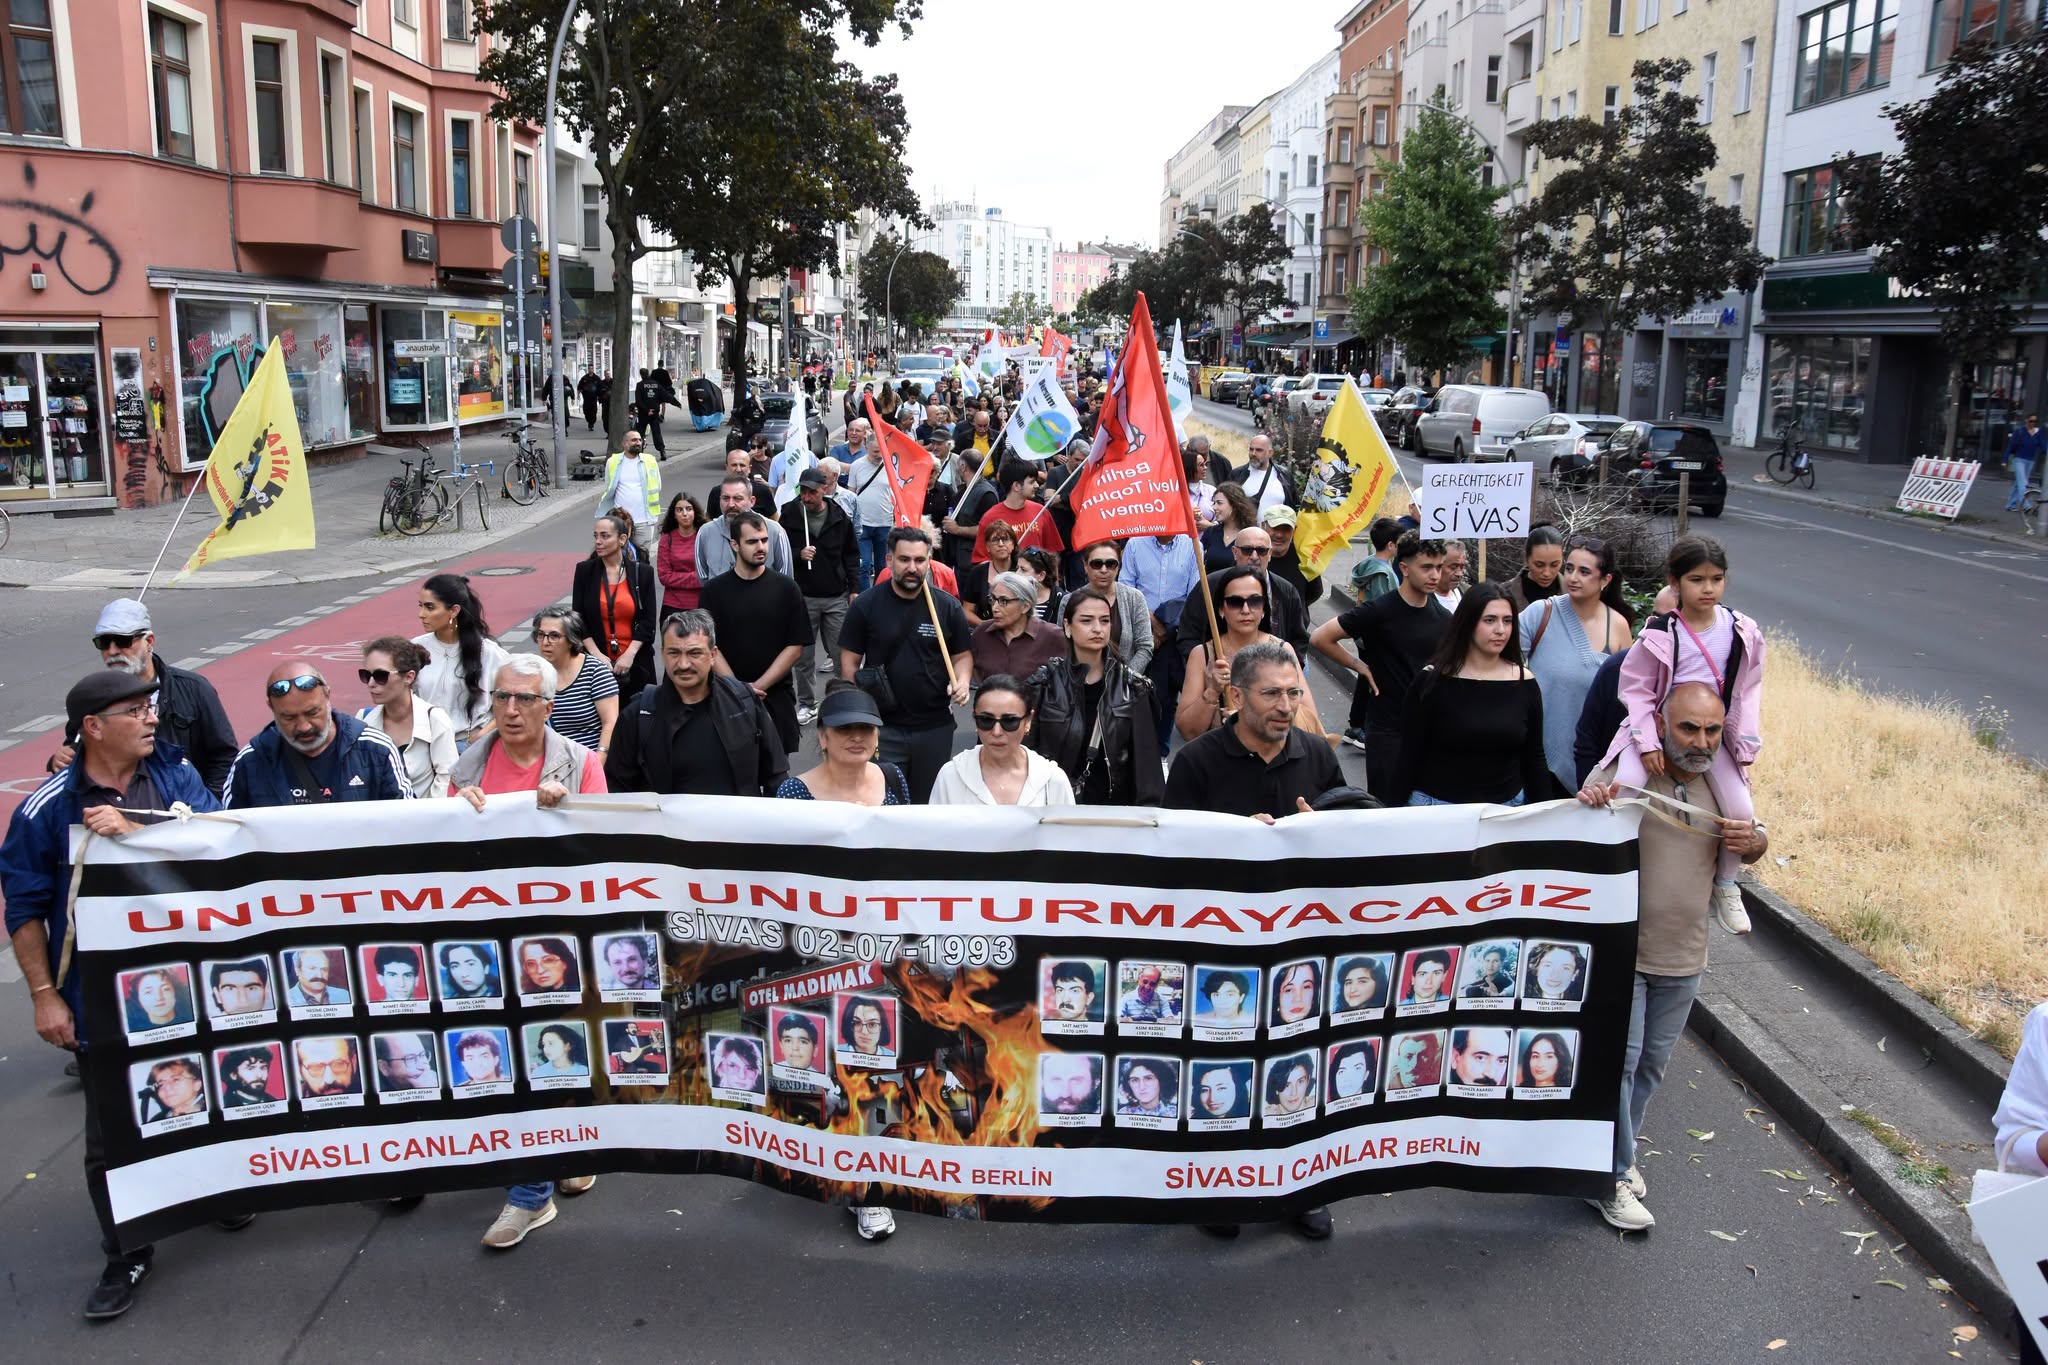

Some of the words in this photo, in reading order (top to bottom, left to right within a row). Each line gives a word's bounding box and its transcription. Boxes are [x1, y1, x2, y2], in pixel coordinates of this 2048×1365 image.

[1431, 472, 1525, 488] GERECHTIGKEIT
[1462, 492, 1486, 504] FÜR
[127, 876, 662, 931] UNUTMADIK
[688, 880, 1591, 932] UNUTTURMAYACAĞIZ
[668, 908, 783, 948] SİVAS
[794, 925, 1016, 967] 02-07-1993
[749, 986, 779, 1006] OTEL
[783, 964, 874, 1001] MADIMAK
[249, 1141, 370, 1176] SİVASLI
[380, 1129, 511, 1162] CANLAR
[521, 1122, 599, 1148] BERLİN
[726, 1121, 824, 1168] SİVASLI
[834, 1150, 961, 1183] CANLAR
[972, 1166, 1053, 1186] BERLİN
[1166, 1163, 1284, 1189] SİVASLI
[1291, 1137, 1398, 1180] CANLAR
[1406, 1135, 1481, 1156] BERLİN
